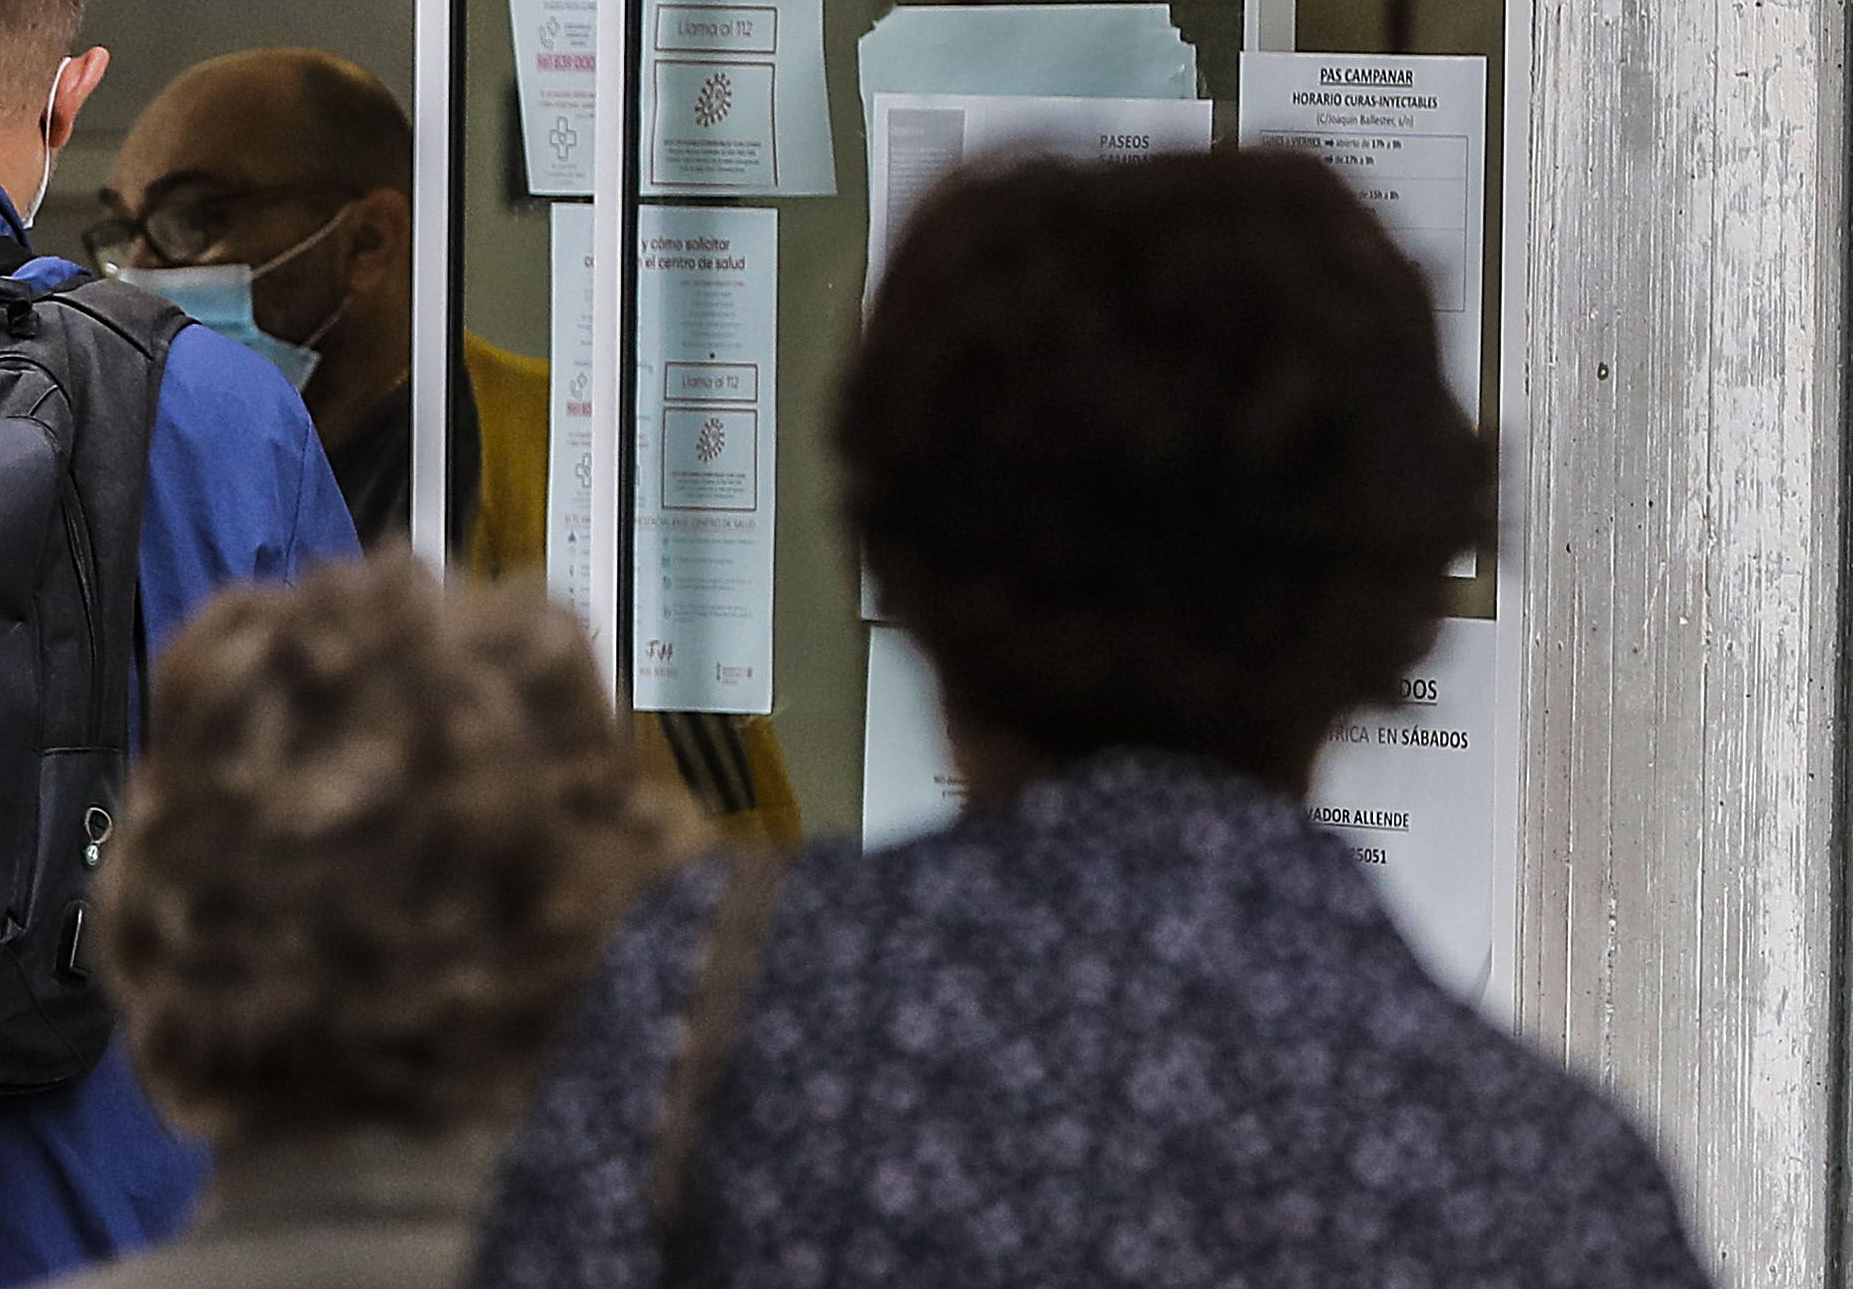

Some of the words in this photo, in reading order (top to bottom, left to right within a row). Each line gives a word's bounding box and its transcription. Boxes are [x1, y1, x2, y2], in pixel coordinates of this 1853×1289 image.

[1320, 67, 1342, 83] PAS
[1345, 68, 1414, 85] CAMPANAR
[1293, 92, 1342, 107] HORARIO
[1345, 94, 1438, 109] CURAS-INYECTABLES
[1100, 135, 1150, 149] PASEOS
[1398, 678, 1438, 701] DOS
[1378, 727, 1397, 744] EN
[1401, 724, 1469, 749] SÁBADOS
[1353, 811, 1410, 828] ALLENDE
[1353, 846, 1388, 865] 5051
